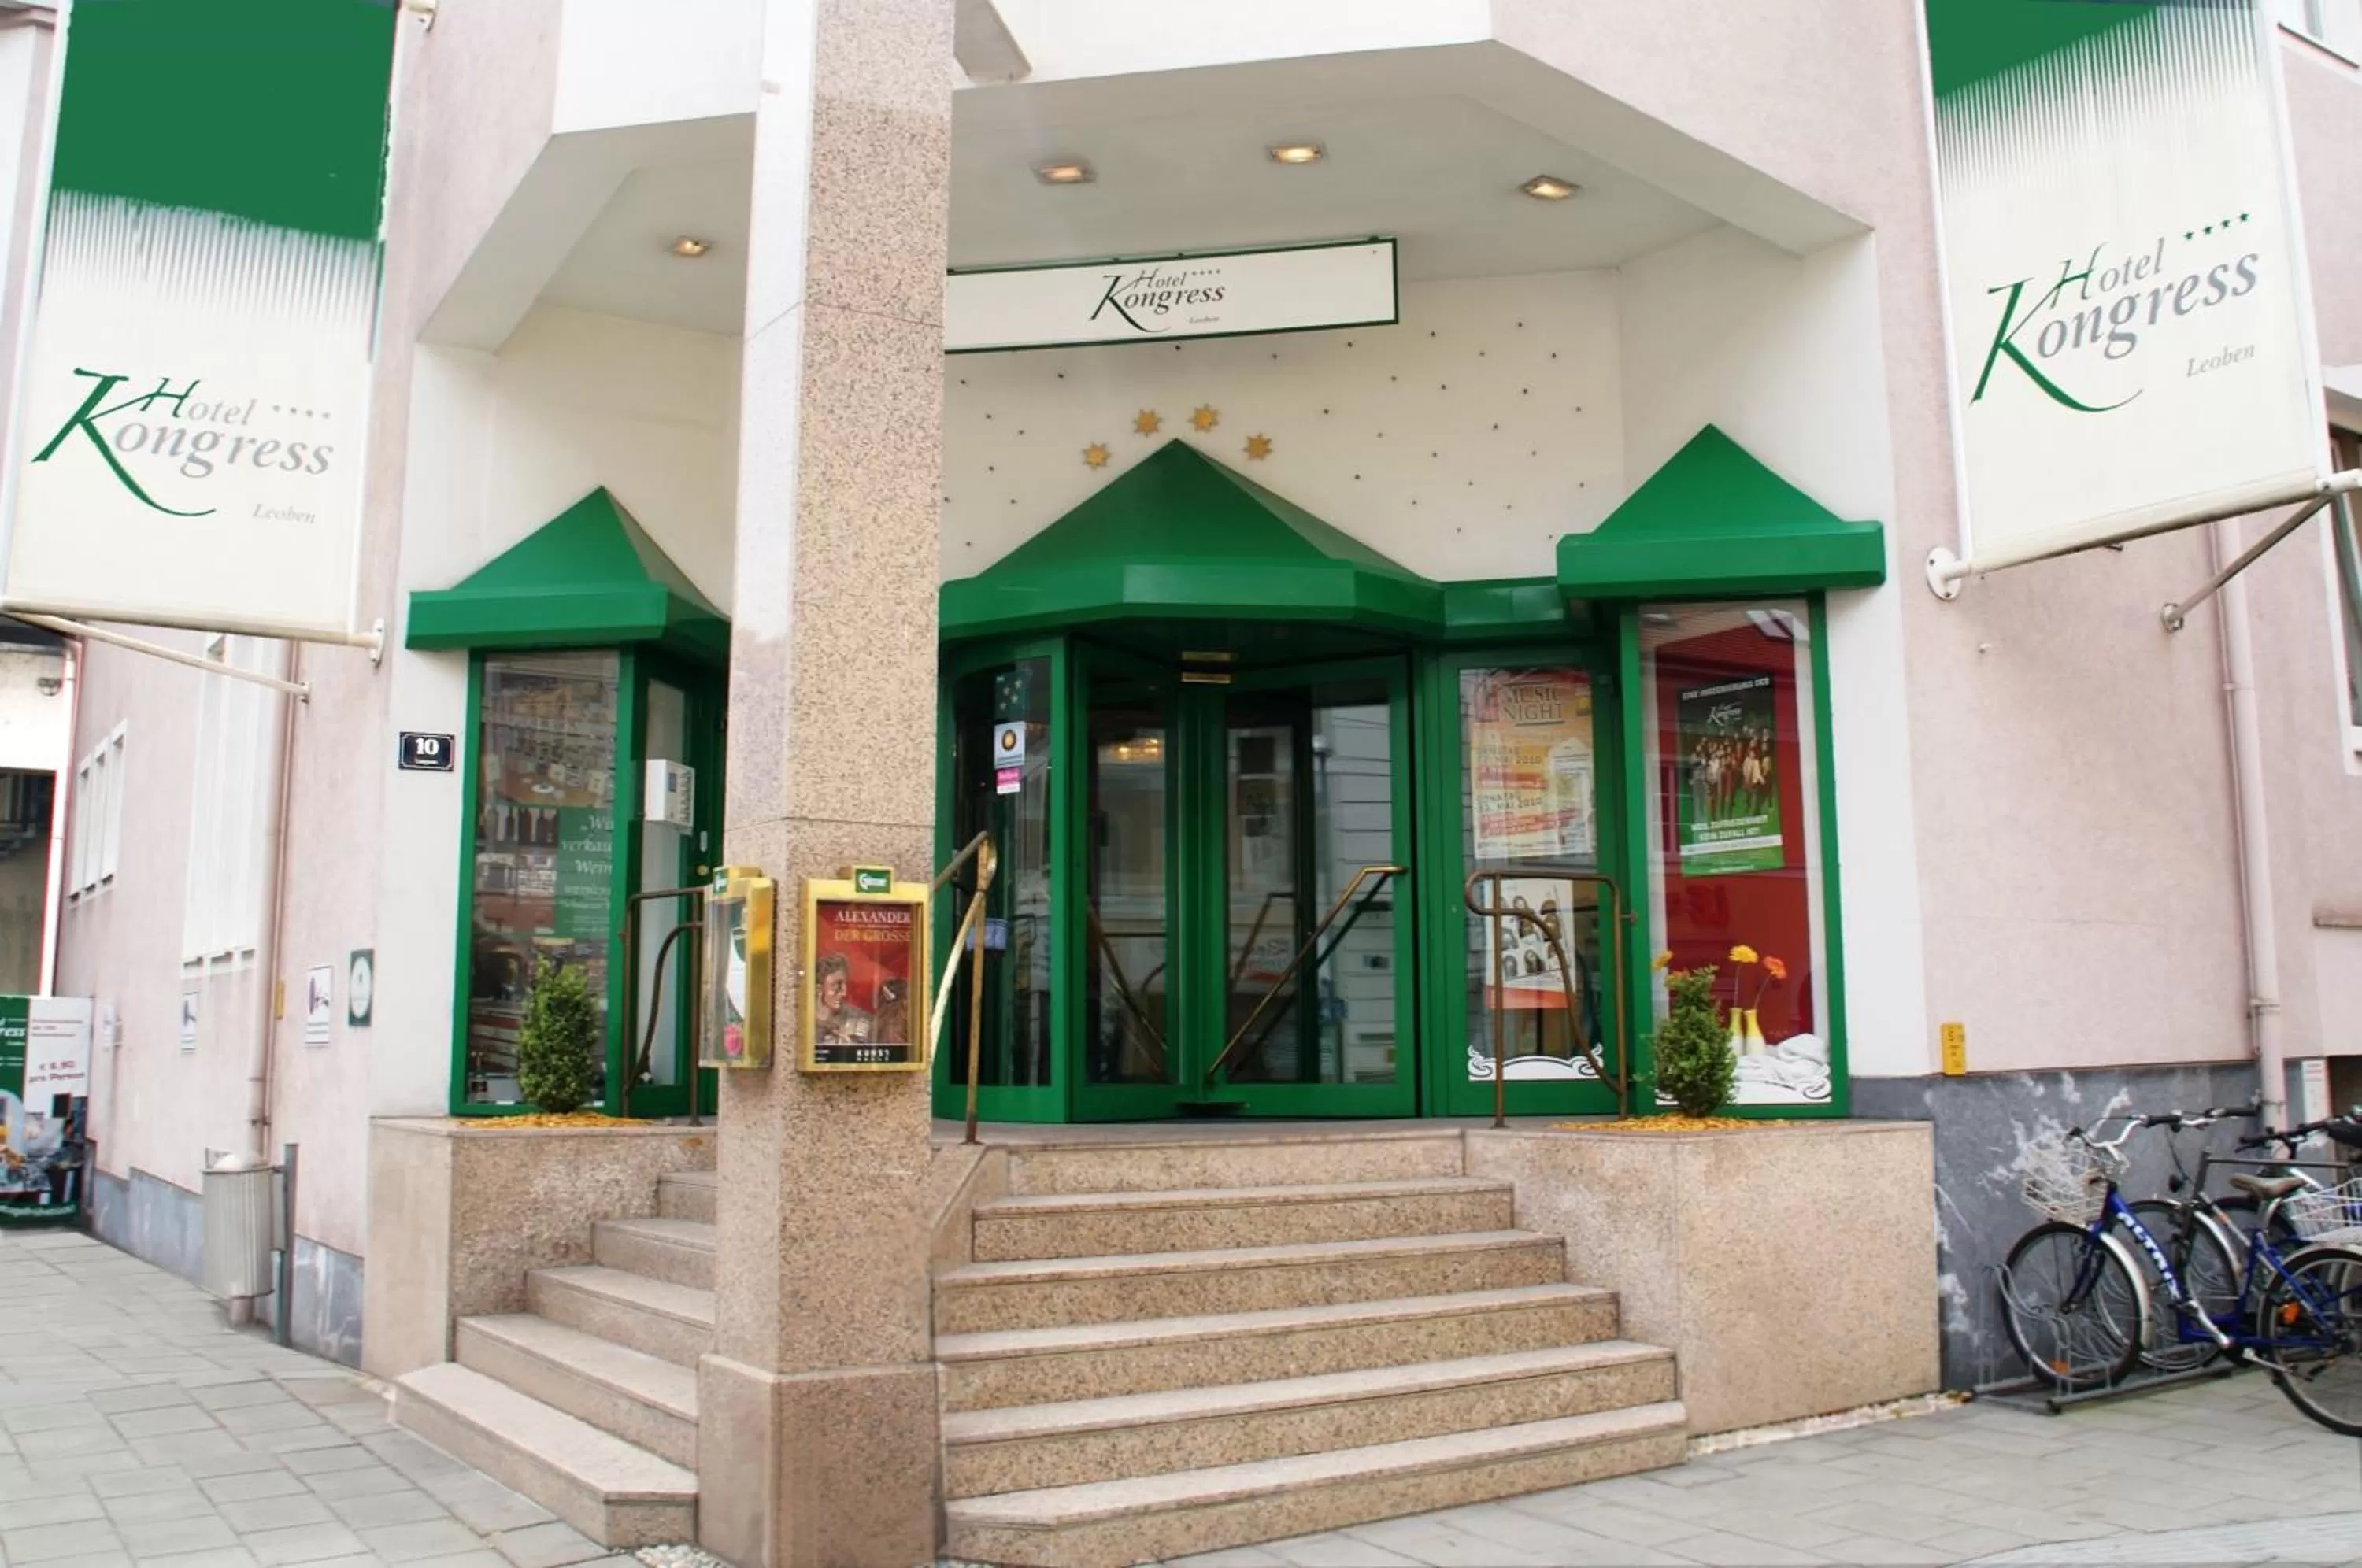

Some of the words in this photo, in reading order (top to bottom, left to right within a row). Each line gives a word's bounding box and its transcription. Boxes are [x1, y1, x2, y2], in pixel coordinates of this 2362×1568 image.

[1132, 267, 1187, 290] Hotel
[2047, 236, 2168, 309] Hotel
[1089, 274, 1226, 332] Kongress
[1968, 253, 2260, 412] Kongress
[2185, 343, 2256, 378] Leoben
[139, 377, 257, 427] Hotel
[31, 367, 335, 517] Kongress
[251, 503, 317, 524] Leoben
[1502, 702, 1563, 722] NIGHT
[415, 738, 440, 755] 10
[835, 929, 861, 942] DER
